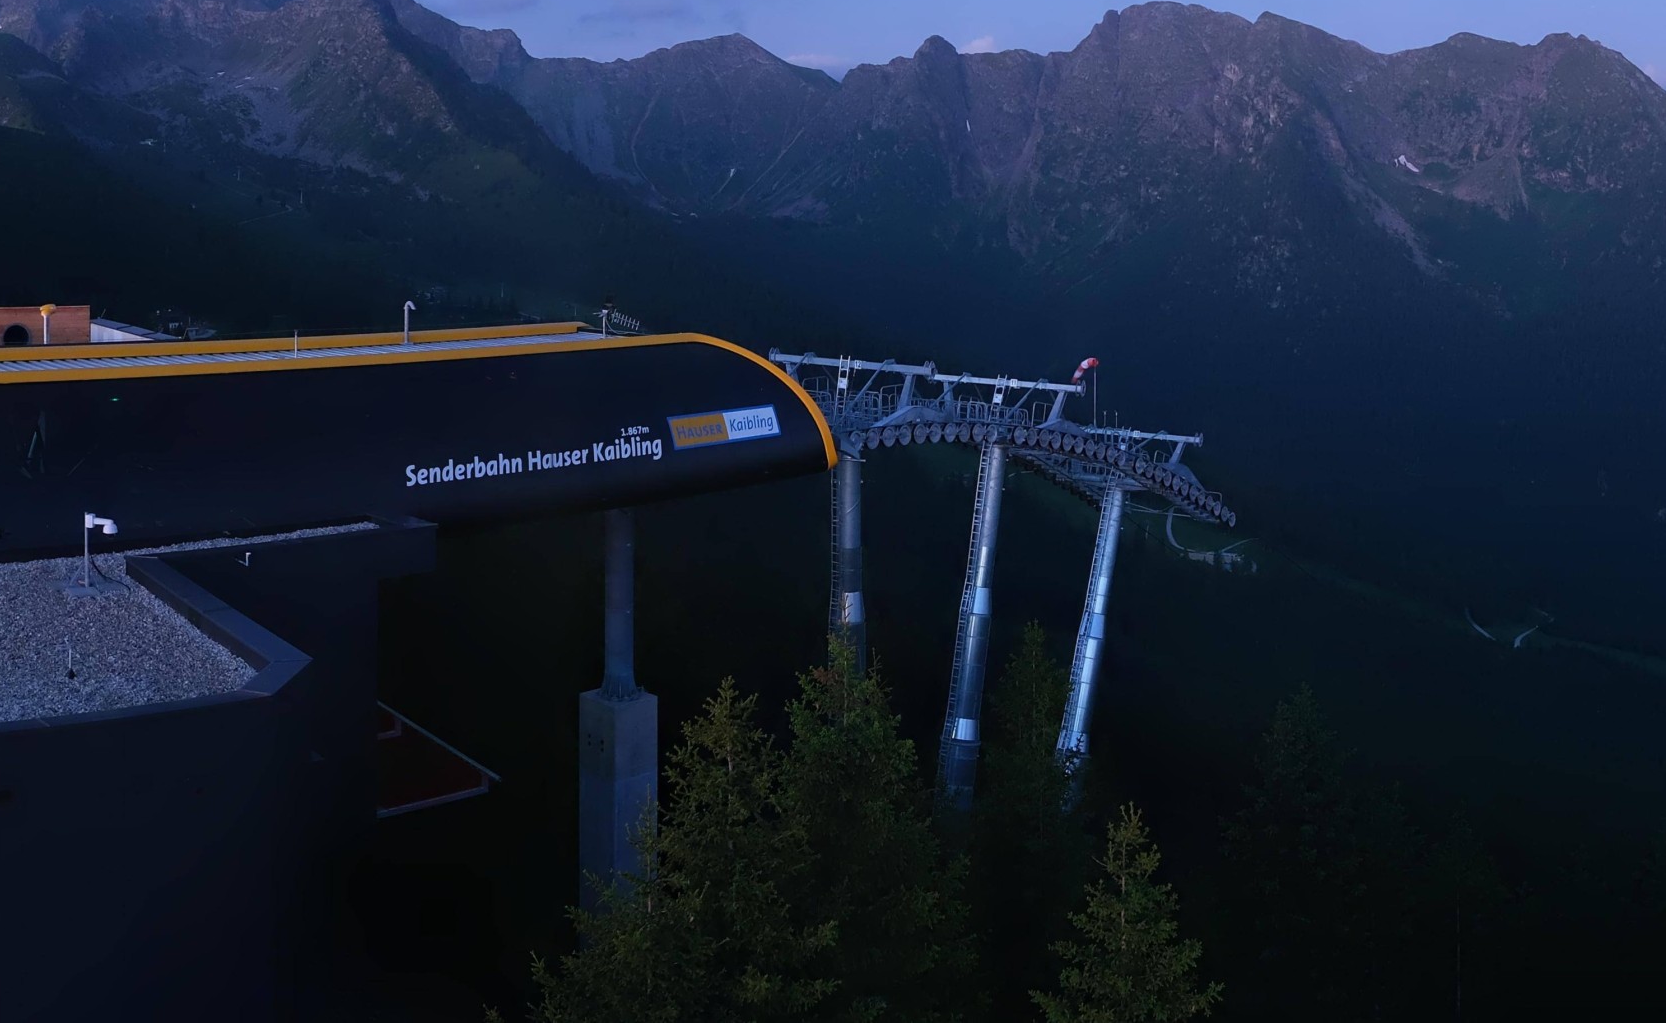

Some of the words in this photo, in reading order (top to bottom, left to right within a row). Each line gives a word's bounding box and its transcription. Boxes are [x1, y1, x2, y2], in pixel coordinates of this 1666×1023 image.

[620, 425, 650, 437] 1.867m
[675, 423, 724, 440] HAUSER
[729, 414, 774, 433] Kaibling
[405, 451, 523, 487] Senderbahn
[527, 445, 589, 472] Hauser
[592, 435, 663, 462] Kaibling
